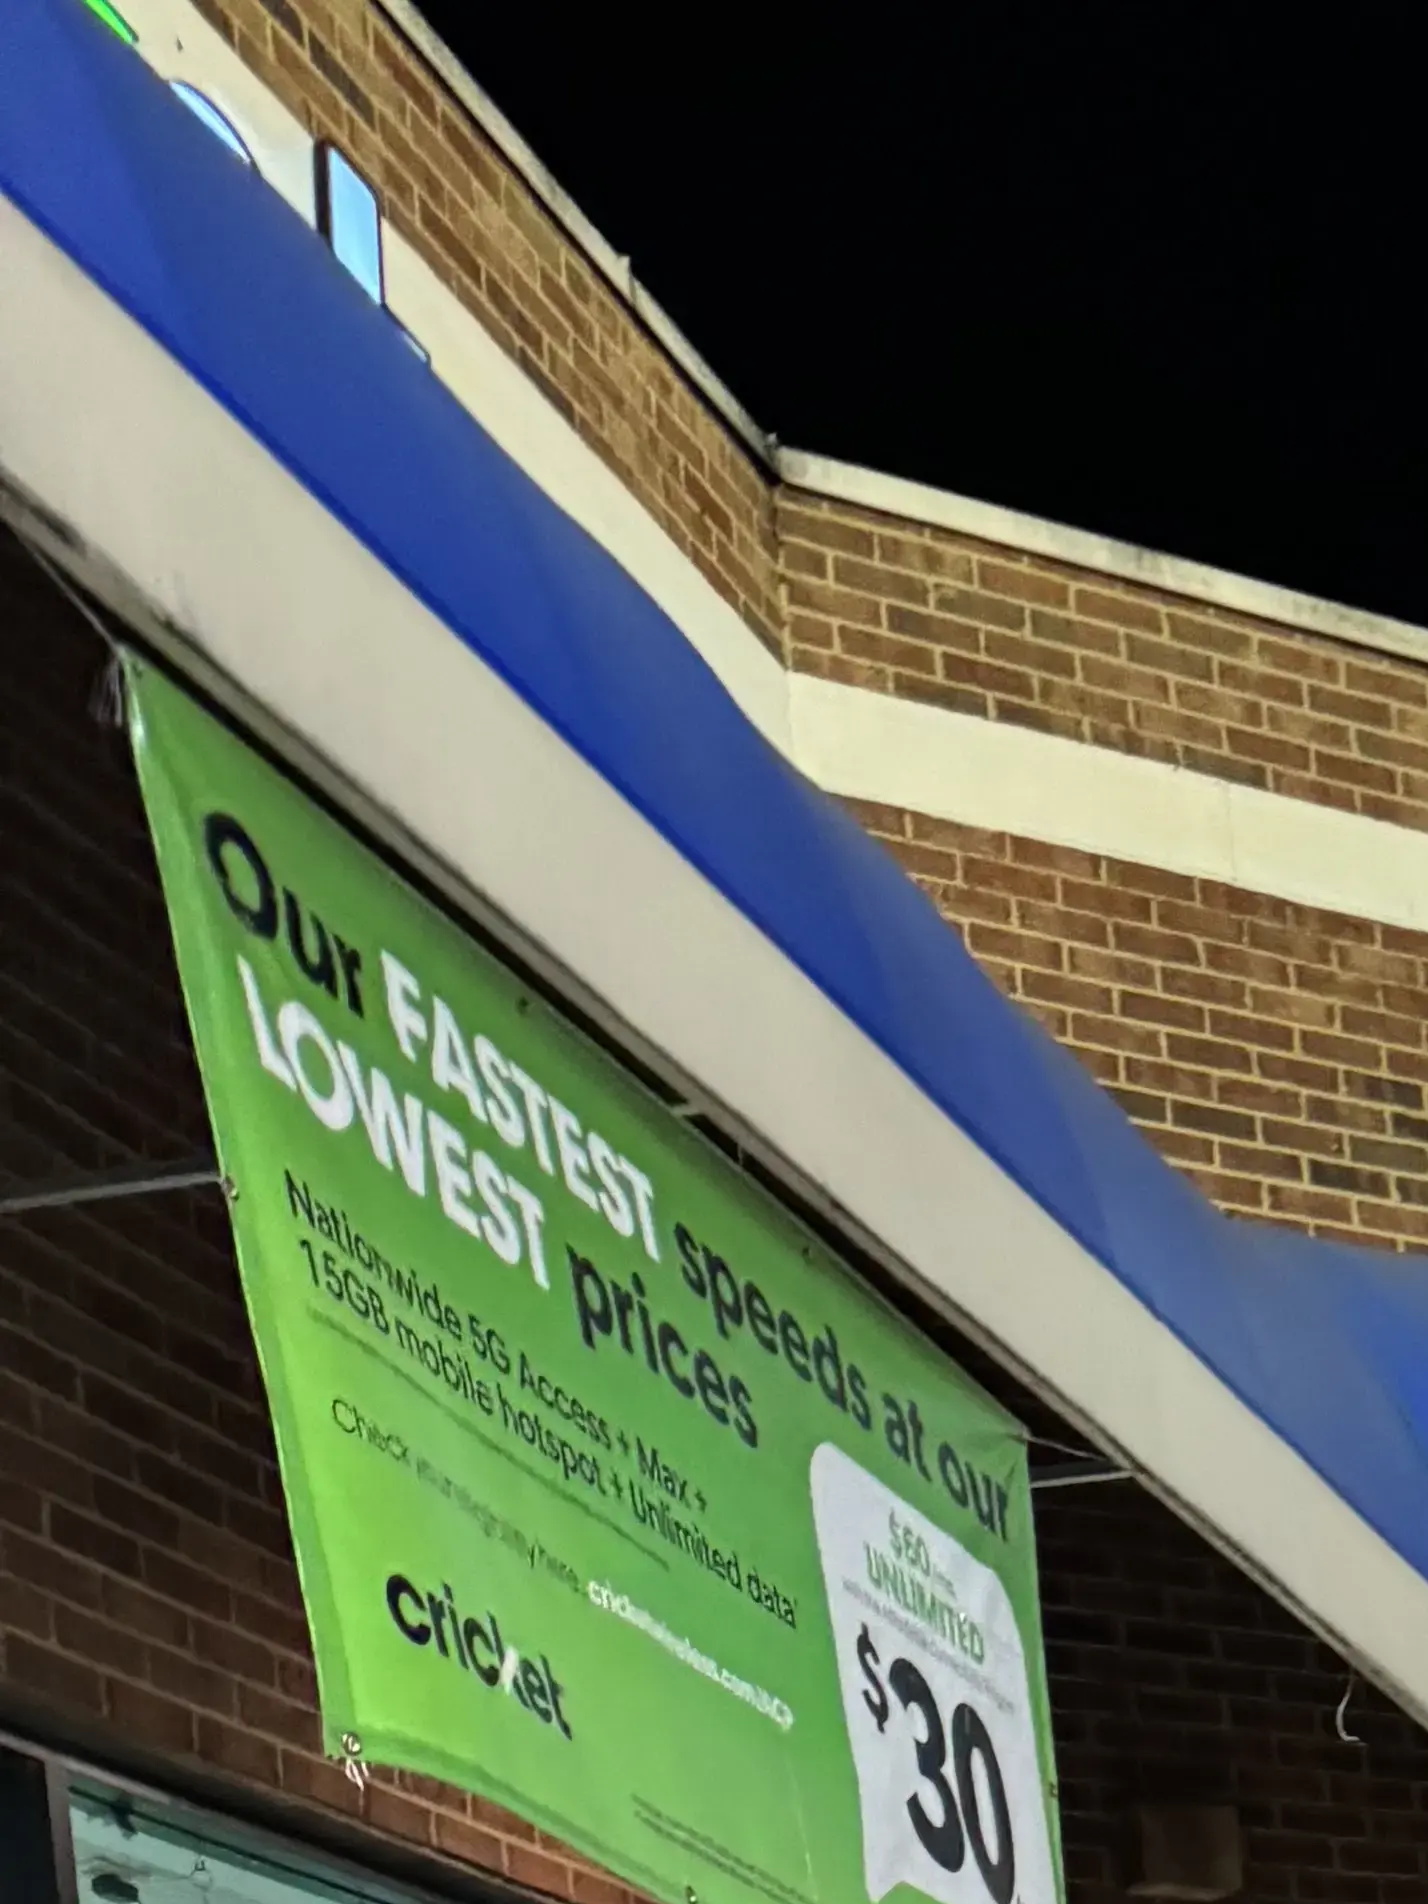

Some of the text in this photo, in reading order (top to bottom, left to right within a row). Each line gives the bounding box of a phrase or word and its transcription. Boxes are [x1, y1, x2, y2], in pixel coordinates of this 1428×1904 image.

[204, 812, 1011, 1543] Our FASTEST speeds at our
[237, 954, 759, 1449] LOWEST prices
[285, 1167, 463, 1342] Nationwide
[467, 1313, 511, 1375] 5G
[519, 1351, 612, 1451] Access
[635, 1435, 692, 1511] Max
[298, 1238, 390, 1336] 15GB
[394, 1316, 494, 1417] mobile
[496, 1381, 607, 1497] hotspot
[628, 1477, 743, 1592] Unlimited
[746, 1565, 798, 1630] data
[386, 1573, 573, 1743] cricket
